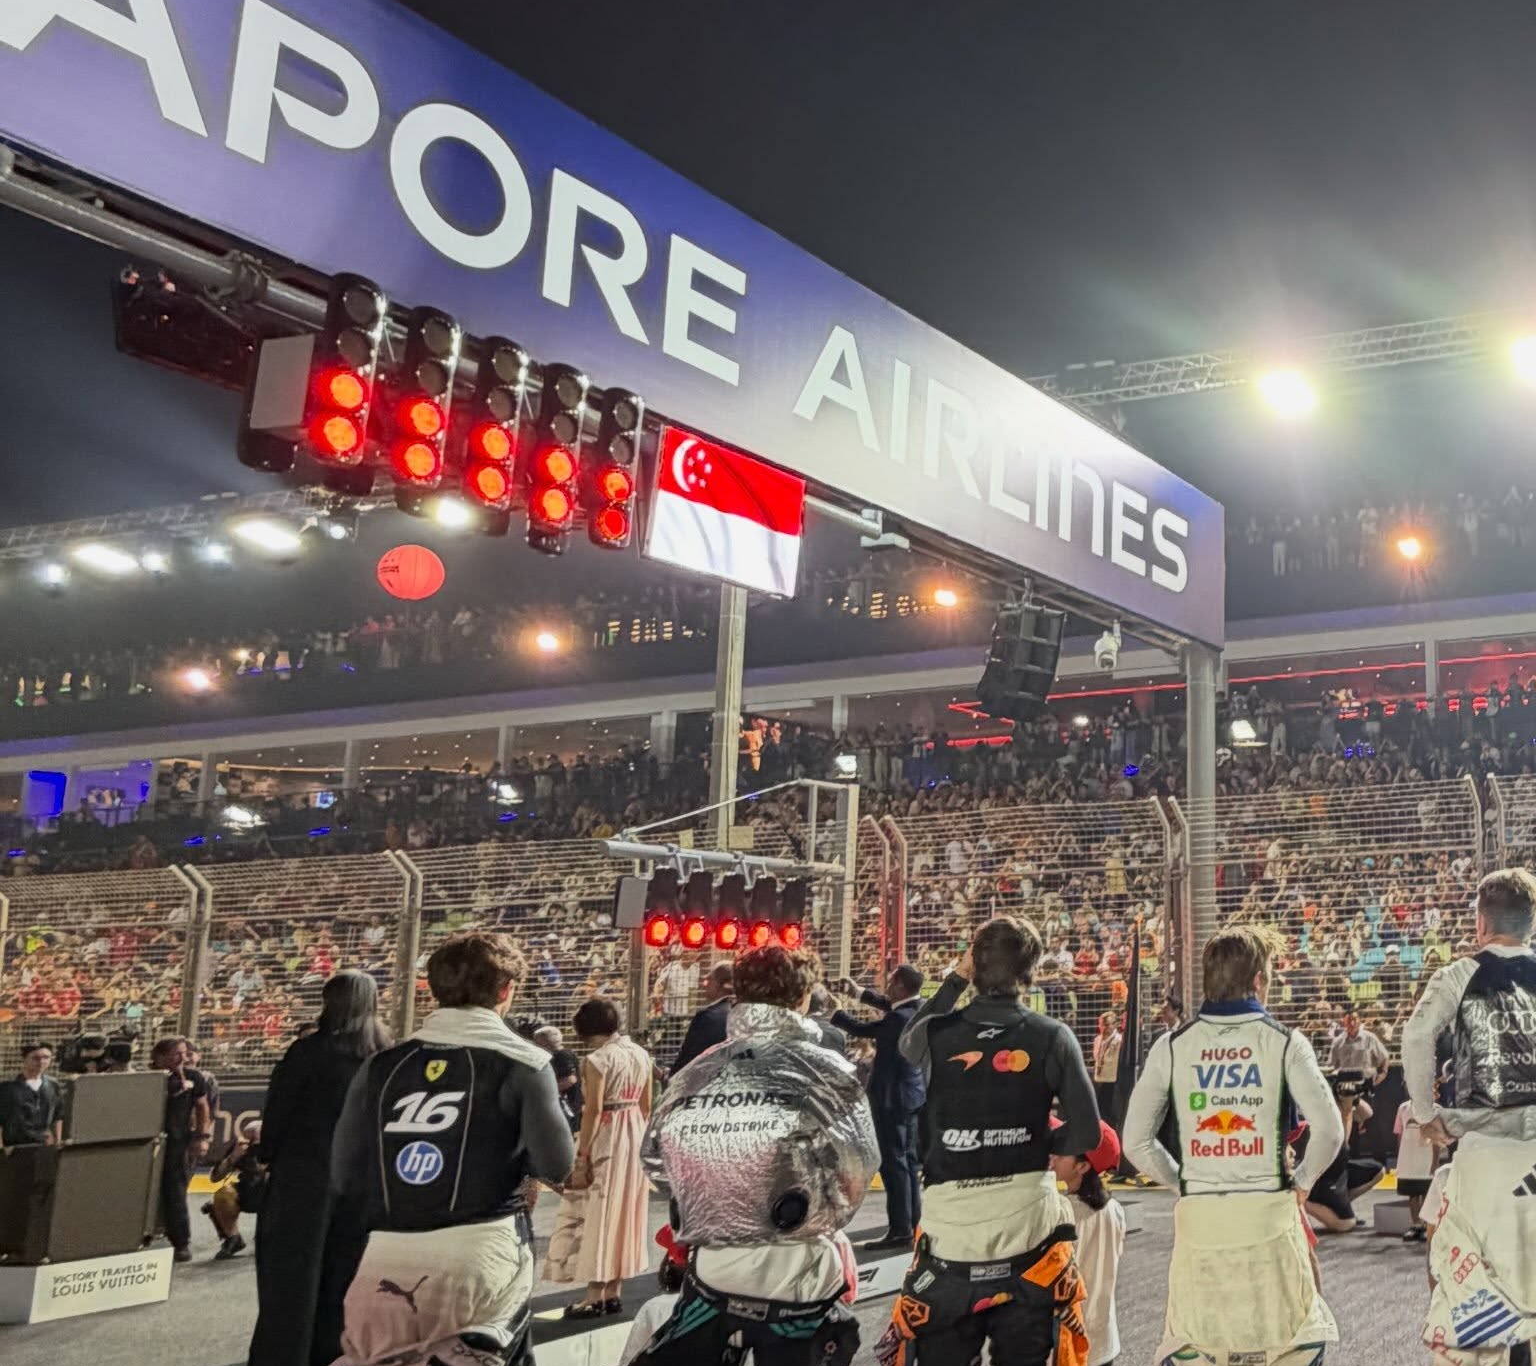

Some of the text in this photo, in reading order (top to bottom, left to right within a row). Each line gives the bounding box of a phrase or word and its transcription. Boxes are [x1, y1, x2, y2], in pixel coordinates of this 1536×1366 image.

[792, 325, 1190, 593] AIRLINES
[1201, 1047, 1253, 1061] HUGO
[1191, 1063, 1263, 1089] VISA
[383, 1091, 466, 1132] 16
[671, 1092, 792, 1111] PETRONAS
[1211, 1095, 1264, 1107] Cash App
[680, 1119, 780, 1137] CROWDSTRIKE
[1190, 1136, 1264, 1157] Red Bull
[400, 1141, 440, 1185] hp
[52, 1271, 98, 1284] VICTORY
[102, 1262, 144, 1278] TRAVELS
[51, 1272, 157, 1299] LOUIS VUITTON
